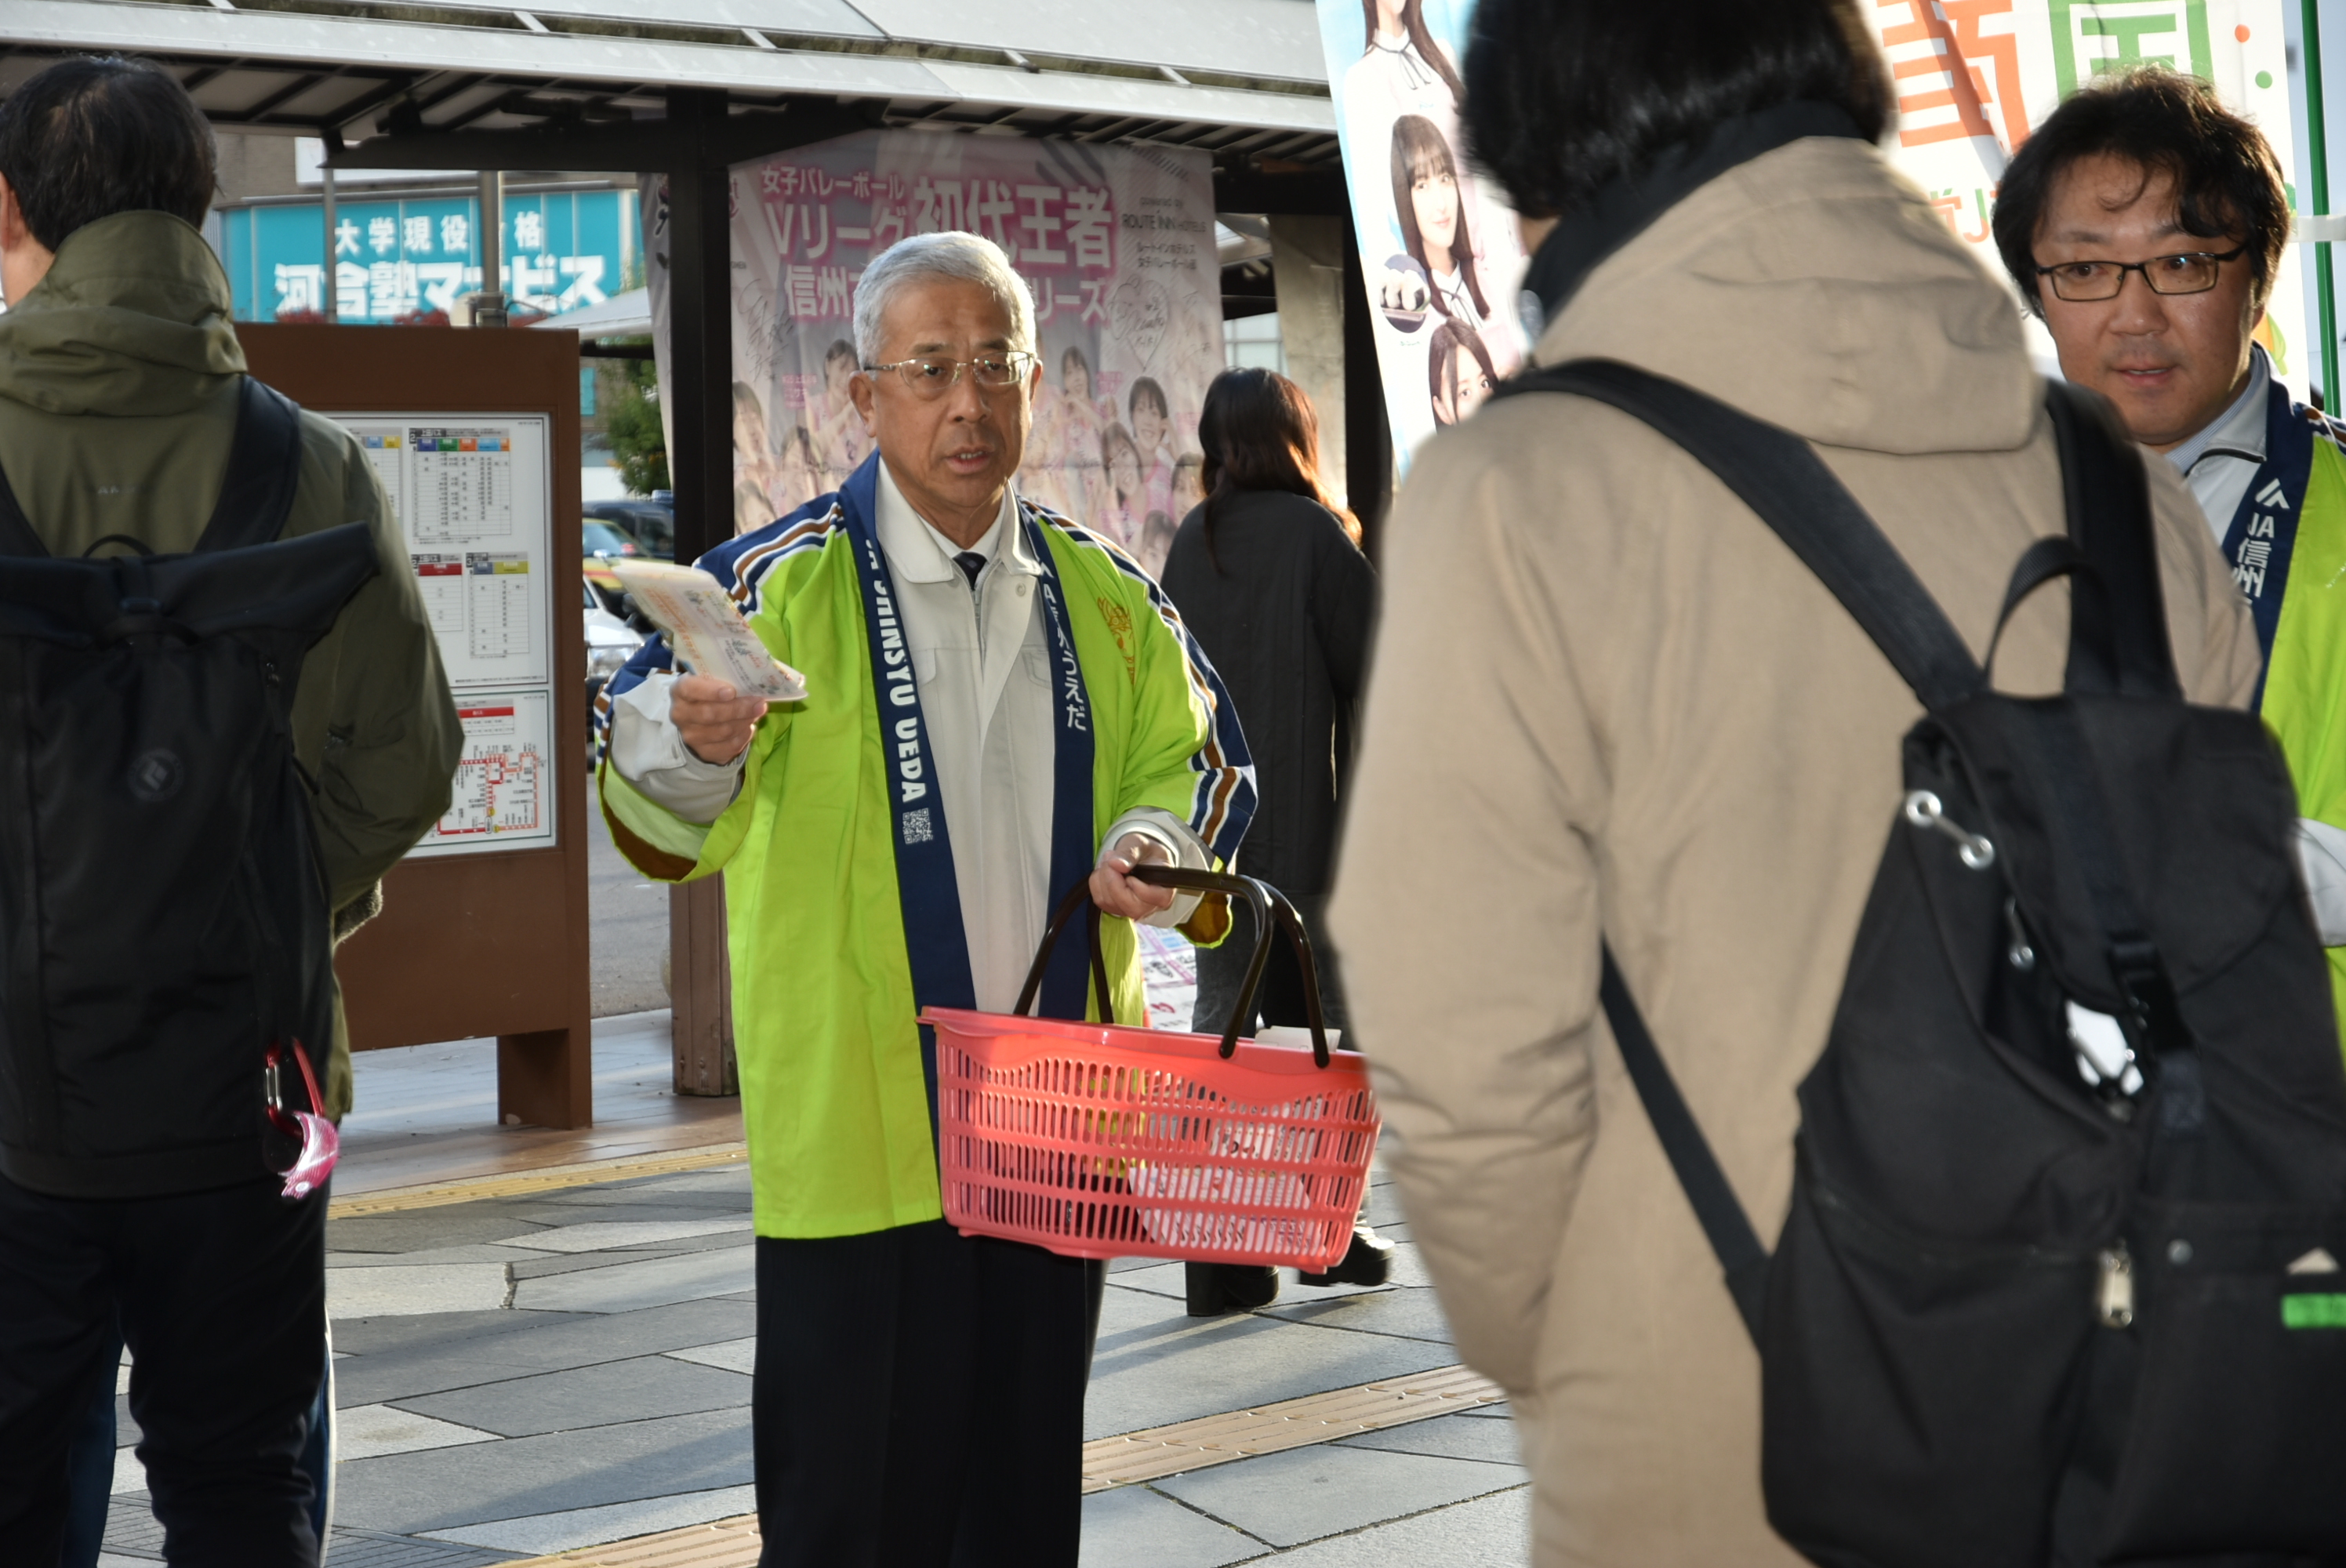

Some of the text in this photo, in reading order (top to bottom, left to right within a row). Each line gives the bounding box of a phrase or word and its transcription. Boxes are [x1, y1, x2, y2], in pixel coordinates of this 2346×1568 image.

[761, 165, 905, 200] 女子バレーボール
[334, 211, 545, 257] 大学現役格
[1122, 213, 1156, 230] ROUTE
[1157, 209, 1176, 230] INN
[786, 264, 860, 316] 信州
[1030, 276, 1109, 322] リーズ
[2247, 512, 2274, 538] JA
[2232, 537, 2272, 600] 信州
[895, 716, 927, 803] UEDA
